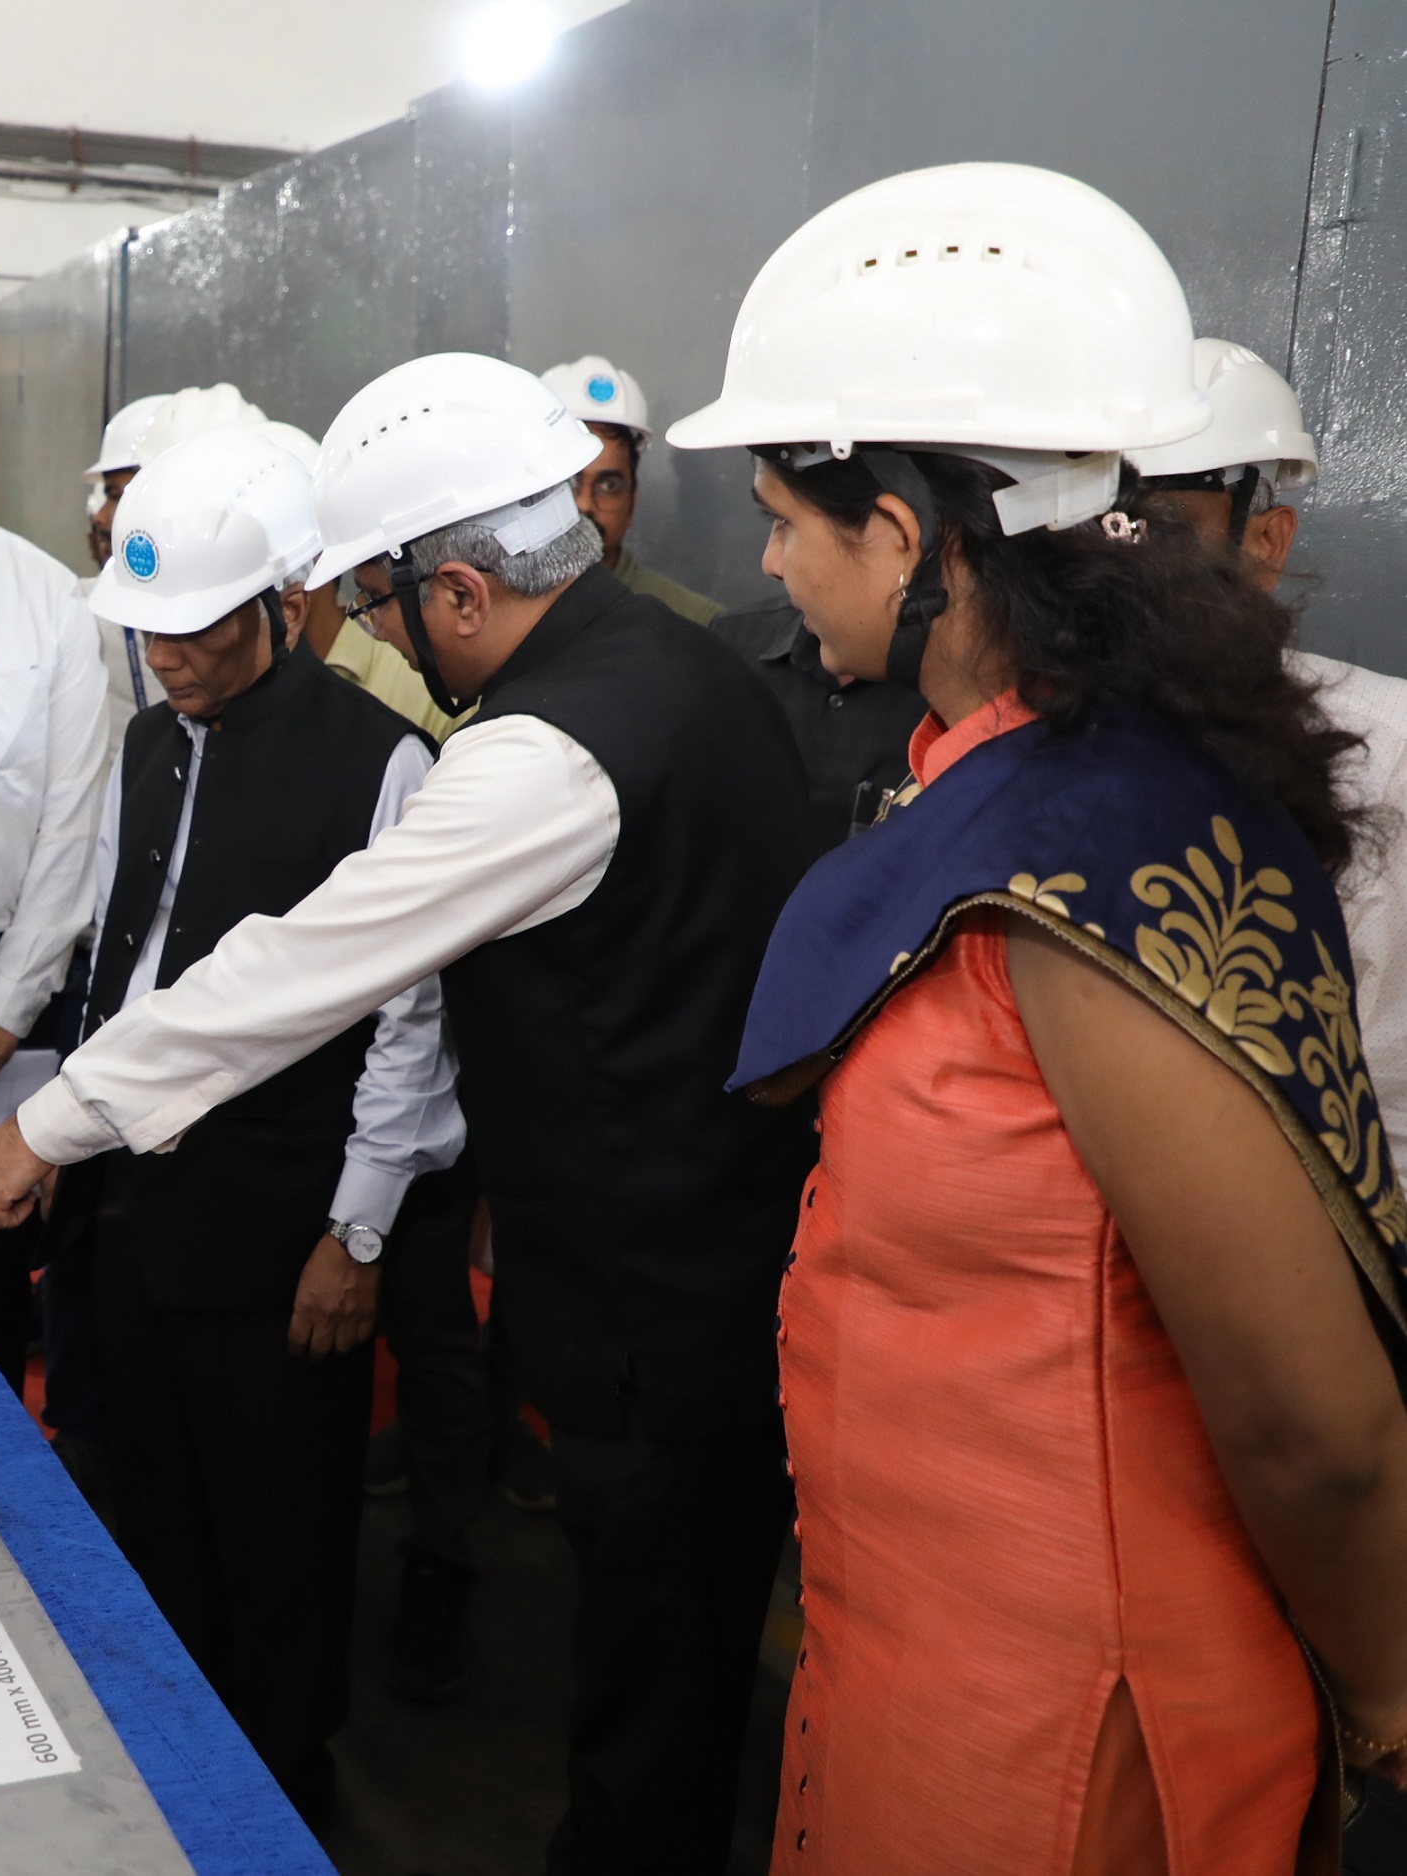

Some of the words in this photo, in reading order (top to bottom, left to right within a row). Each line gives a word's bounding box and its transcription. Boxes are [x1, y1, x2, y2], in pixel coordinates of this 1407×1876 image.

[7, 1686, 24, 1697] x
[13, 1699, 42, 1730] mm
[26, 1732, 58, 1764] 600
